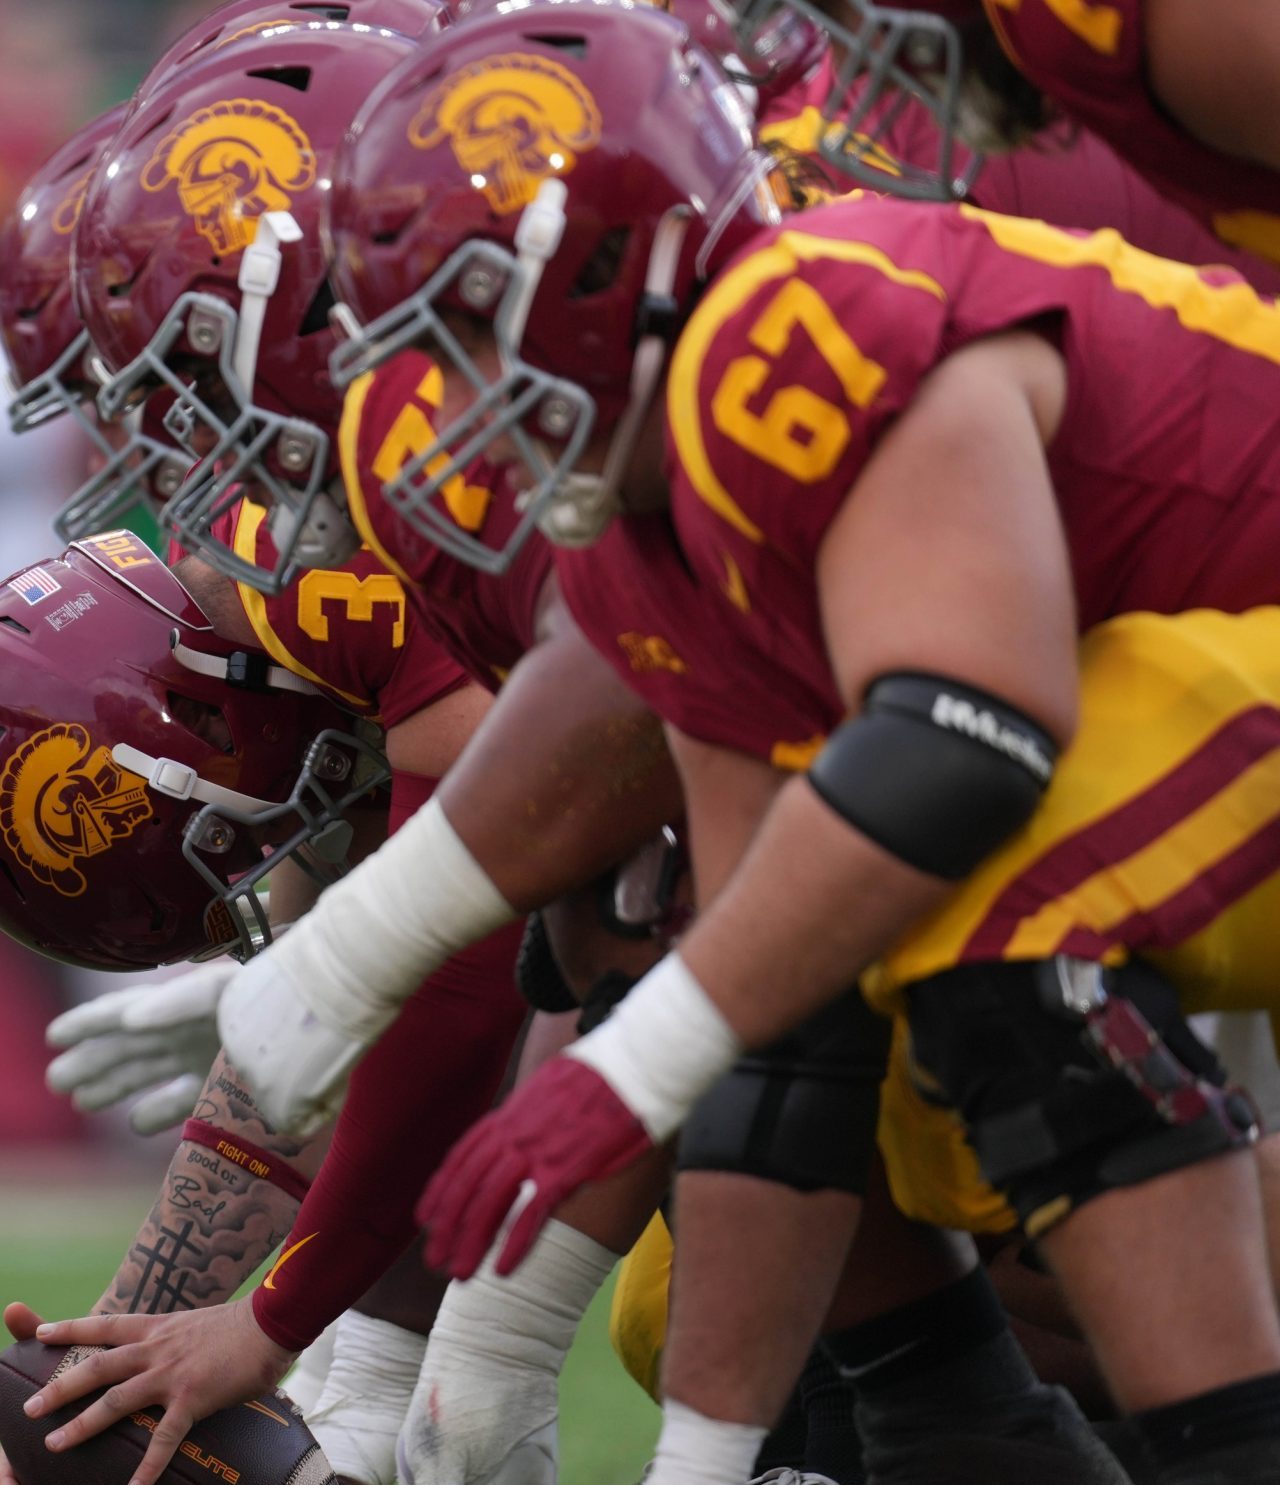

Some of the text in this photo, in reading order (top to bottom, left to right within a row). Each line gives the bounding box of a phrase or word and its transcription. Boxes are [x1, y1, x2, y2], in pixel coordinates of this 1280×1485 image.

[711, 277, 887, 483] 67
[372, 365, 490, 532] 7
[88, 535, 152, 570] FIG
[297, 542, 406, 649] 3
[186, 1149, 238, 1185] good or
[217, 1140, 270, 1178] FIGHT ON!
[168, 1175, 227, 1224] Bad
[180, 1440, 241, 1485] ELITE
